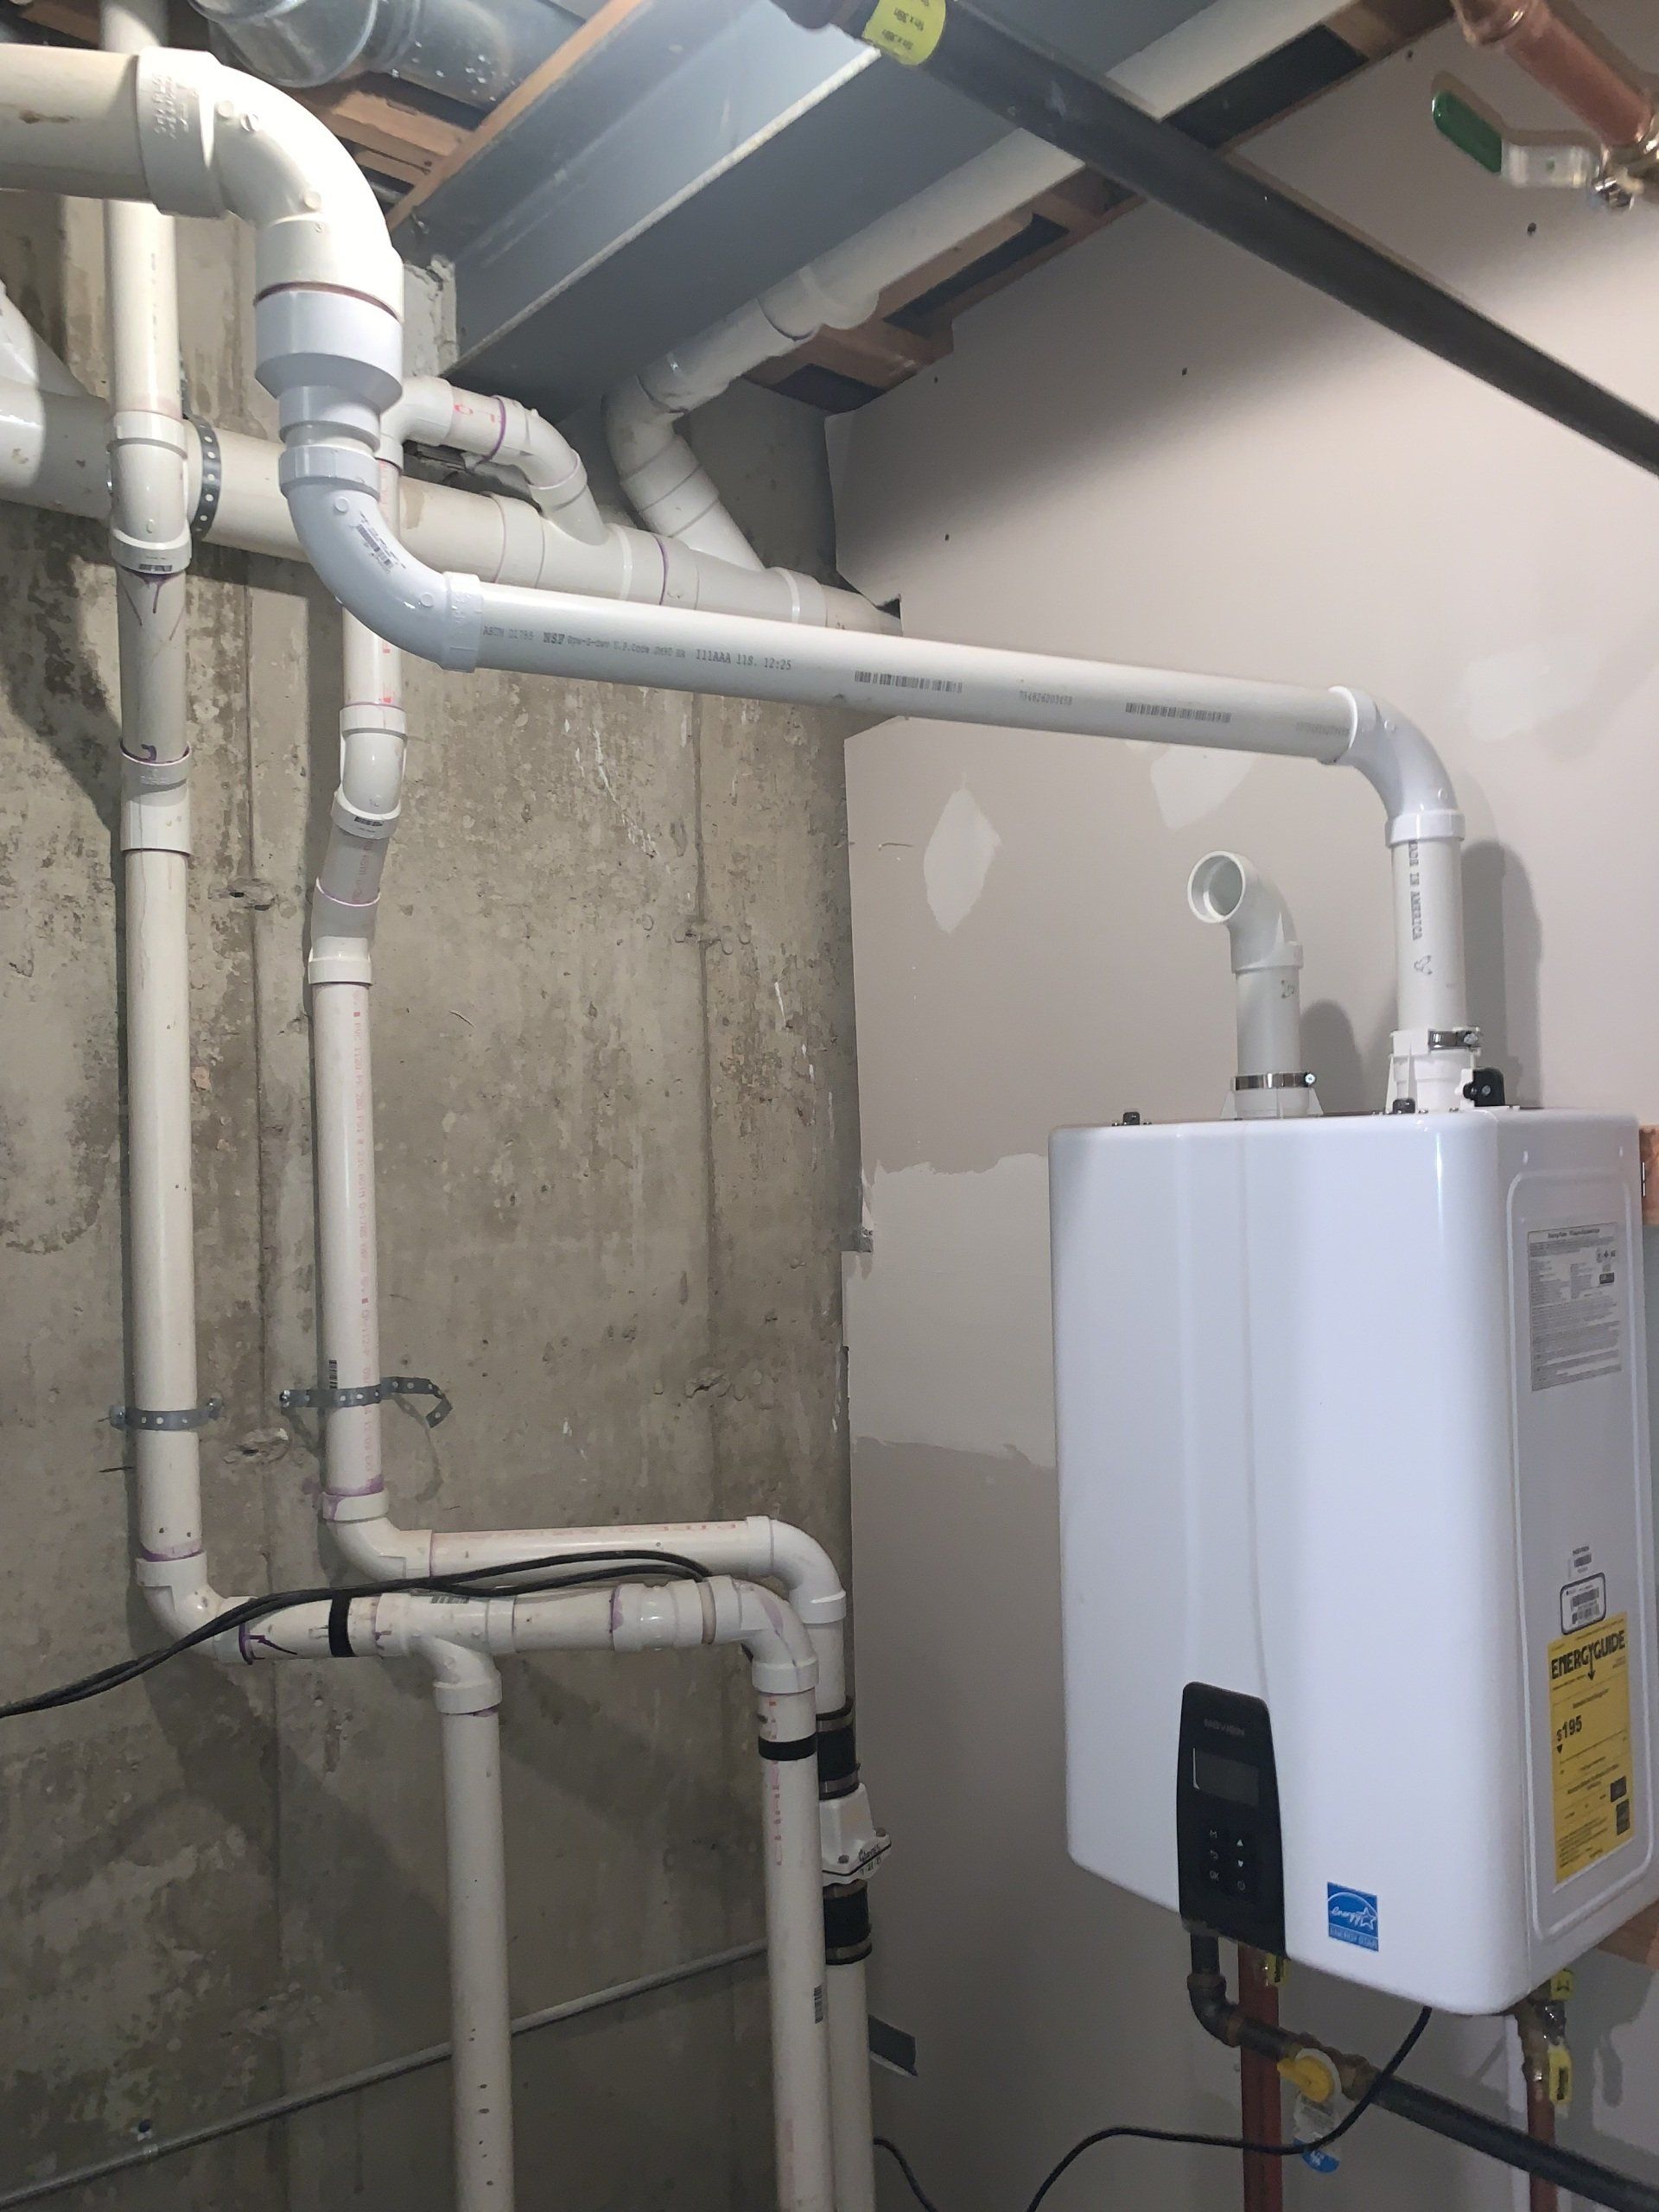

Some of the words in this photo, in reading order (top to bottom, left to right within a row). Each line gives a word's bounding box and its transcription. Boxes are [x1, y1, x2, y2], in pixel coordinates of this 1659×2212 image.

[543, 632, 565, 645] NSF
[764, 658, 791, 671] 12:25
[1409, 872, 1420, 886] IN
[1410, 891, 1422, 941] AMERICA
[1556, 1714, 1582, 1741] $195
